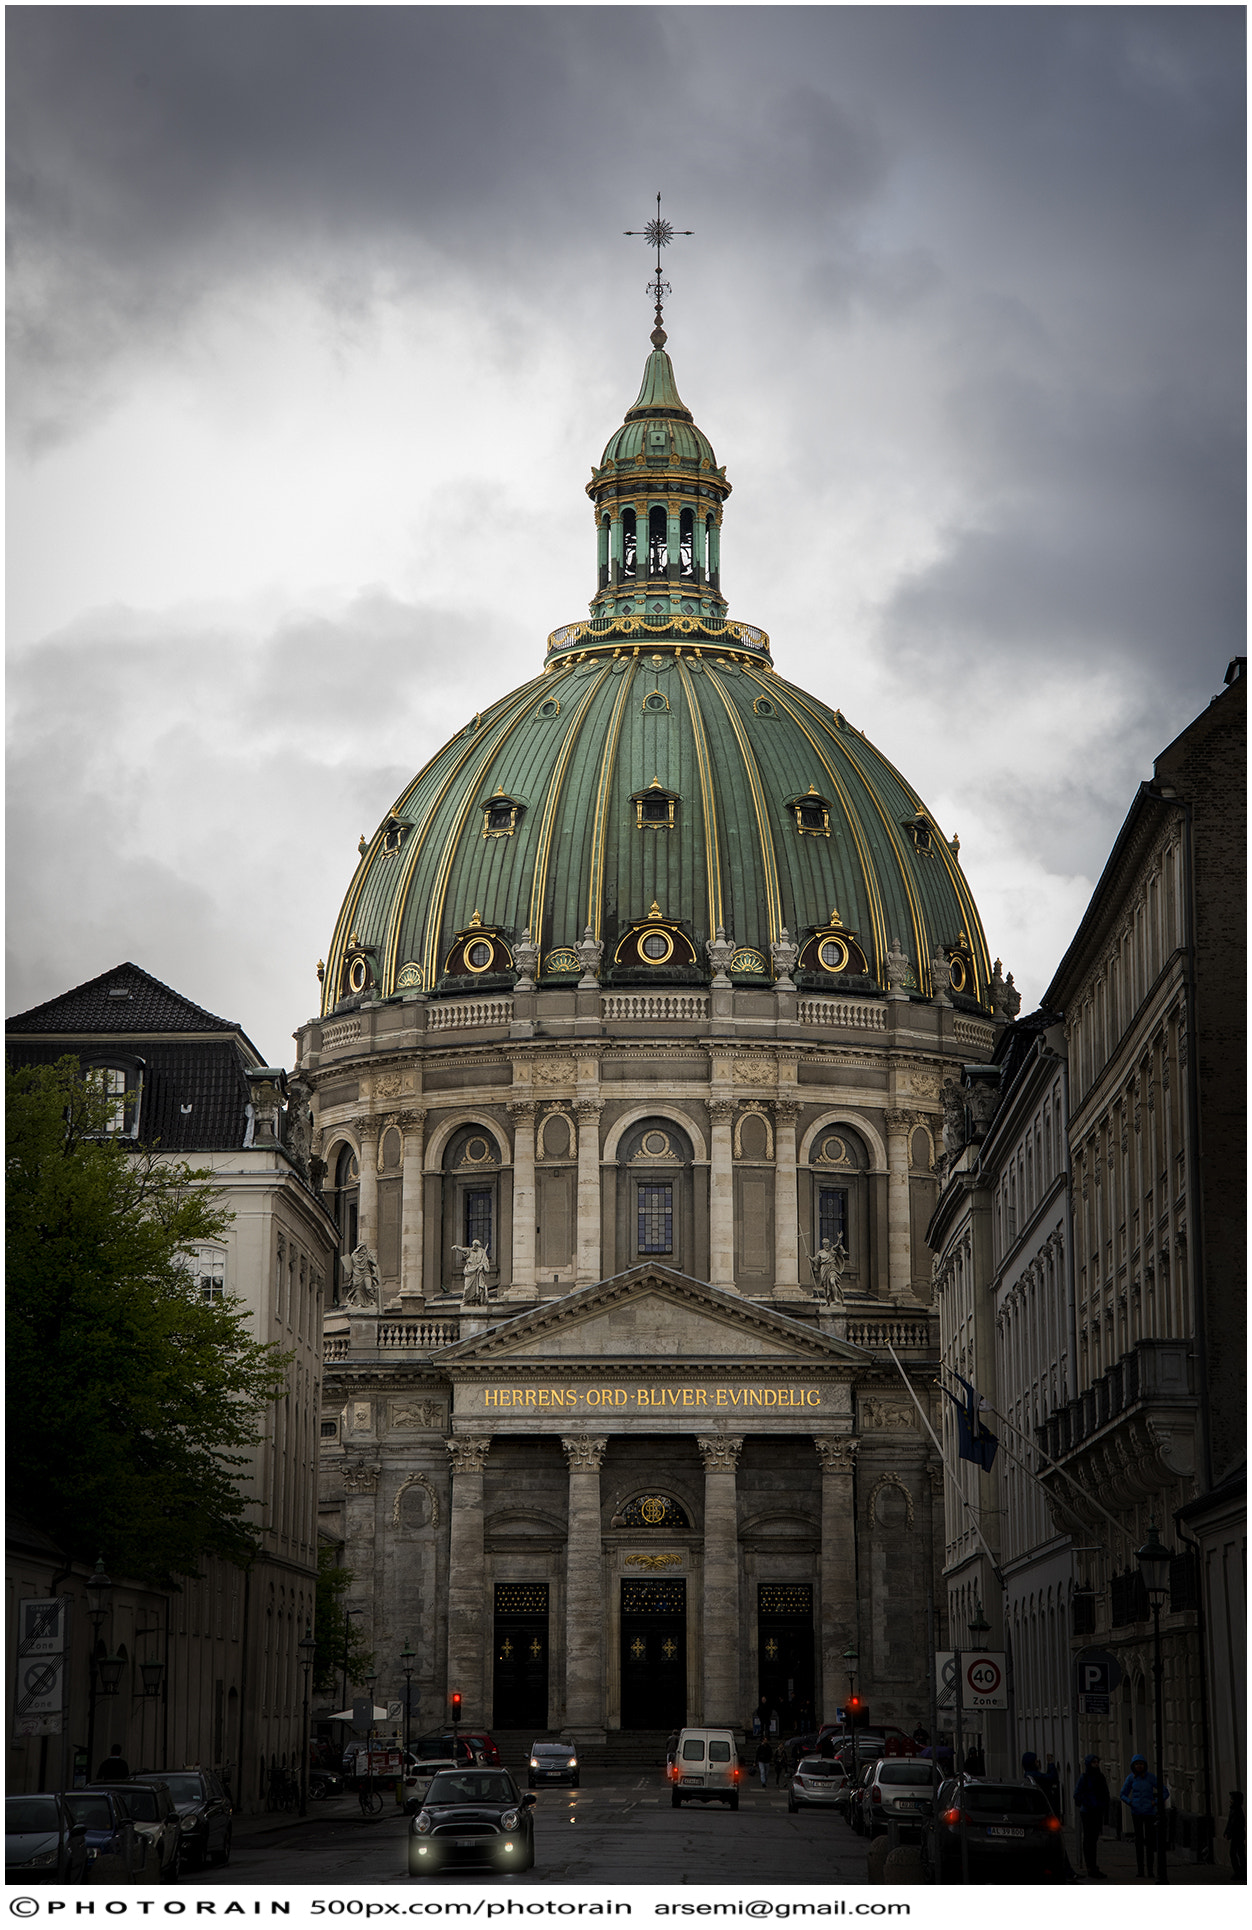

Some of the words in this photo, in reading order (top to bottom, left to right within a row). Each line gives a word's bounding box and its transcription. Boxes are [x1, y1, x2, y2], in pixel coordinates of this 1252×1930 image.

[484, 1388, 578, 1407] HERRENS
[585, 1388, 629, 1407] ORD
[636, 1388, 709, 1407] BLIVER
[715, 1388, 821, 1407] EVINDELIG
[973, 1669, 994, 1683] 40
[1085, 1665, 1102, 1691] P
[973, 1696, 997, 1705] Zone
